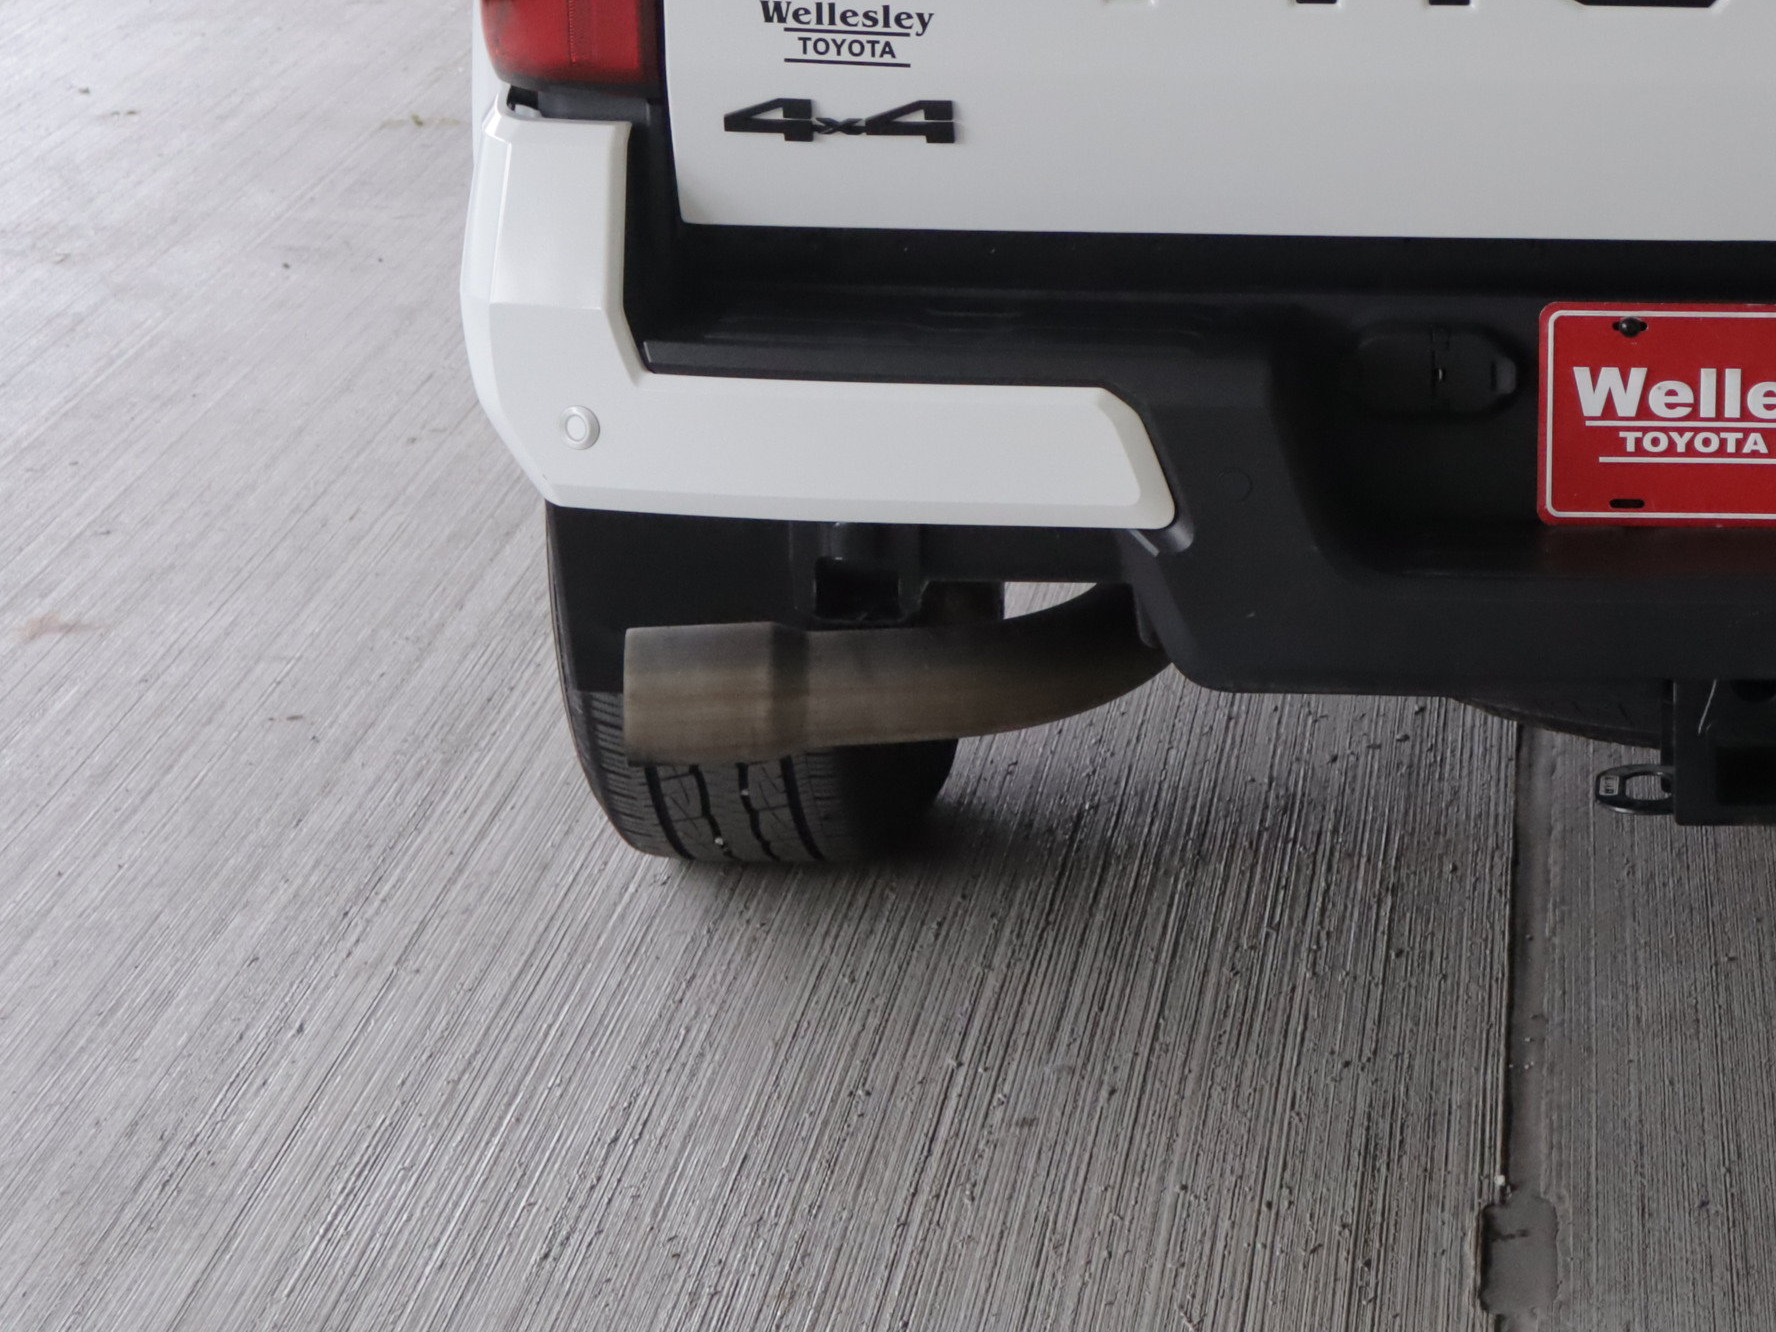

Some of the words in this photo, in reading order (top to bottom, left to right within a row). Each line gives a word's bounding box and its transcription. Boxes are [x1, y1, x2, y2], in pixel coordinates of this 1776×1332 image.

[759, 0, 935, 37] Wellesley
[797, 36, 897, 59] TOYOTA
[1619, 430, 1769, 455] TOYOTA
